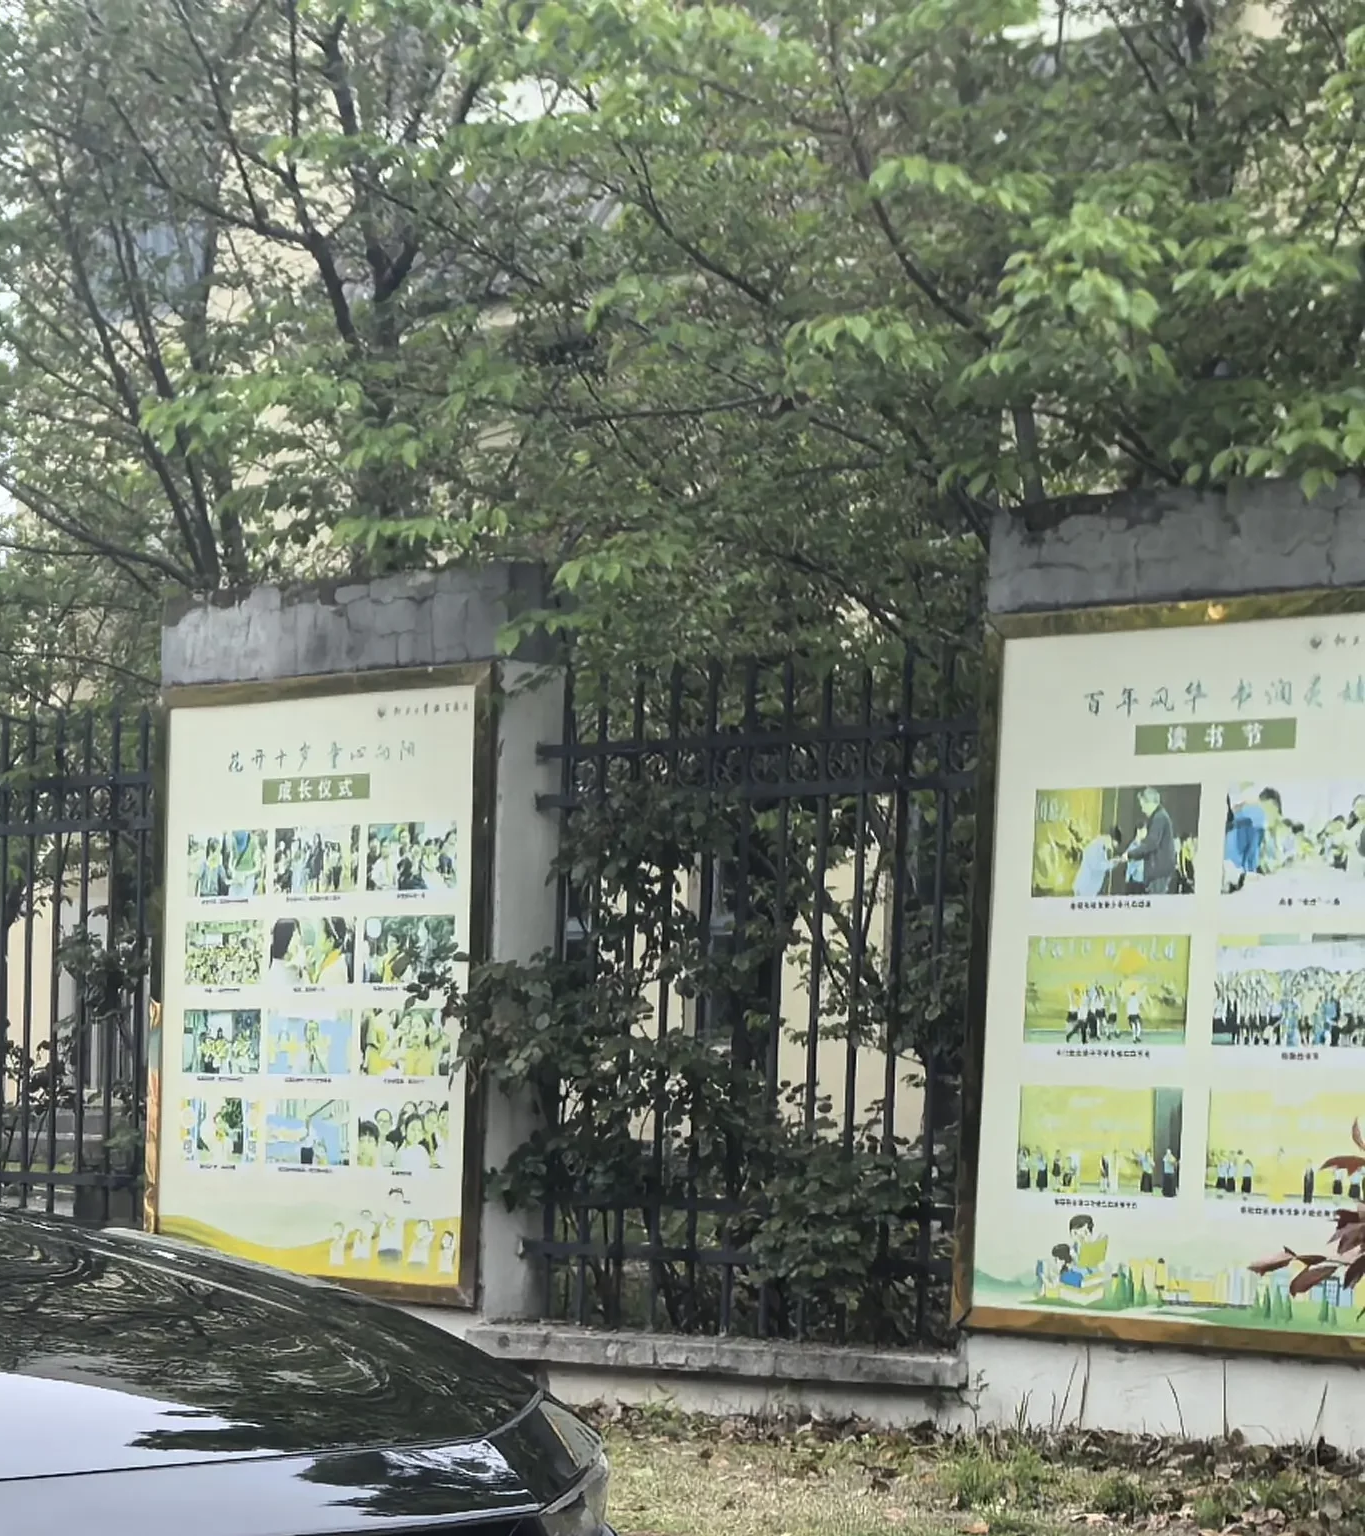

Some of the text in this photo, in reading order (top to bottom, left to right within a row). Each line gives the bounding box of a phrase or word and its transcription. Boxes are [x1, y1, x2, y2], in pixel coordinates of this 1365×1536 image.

[1167, 721, 1264, 751] 读书节
[276, 777, 354, 801] 成长仪式
